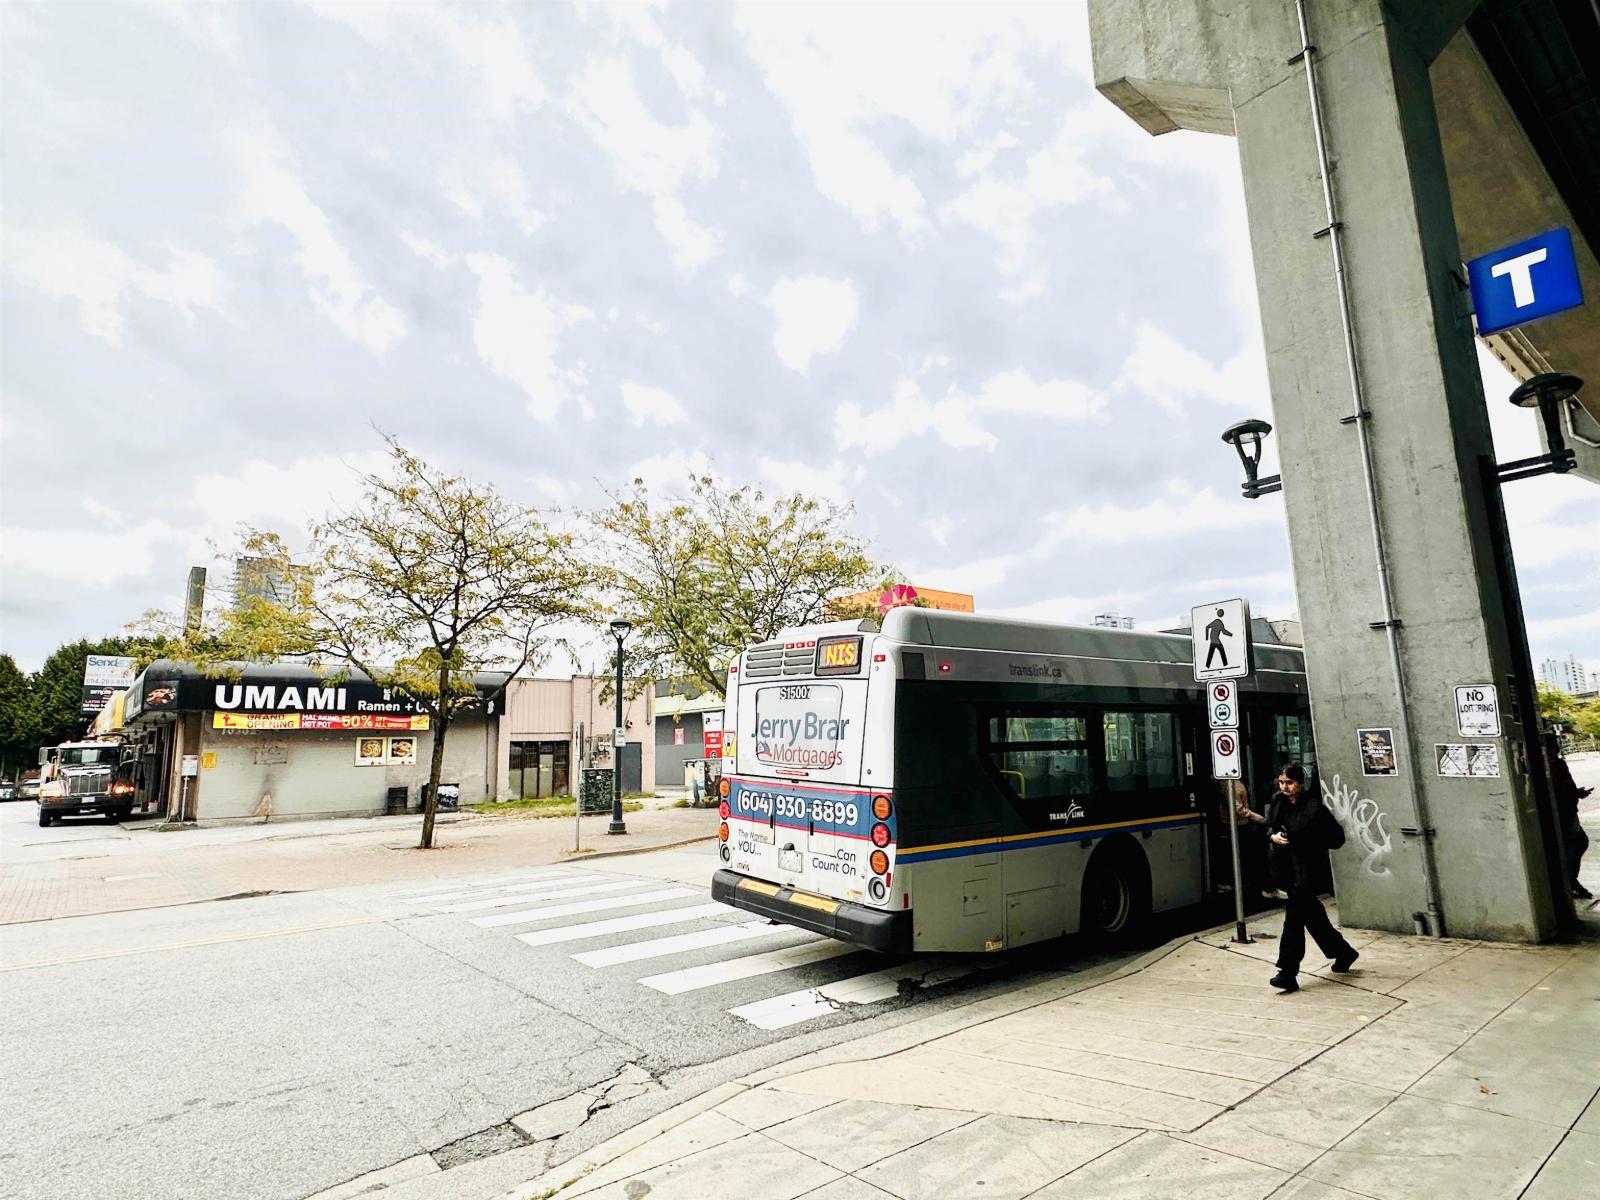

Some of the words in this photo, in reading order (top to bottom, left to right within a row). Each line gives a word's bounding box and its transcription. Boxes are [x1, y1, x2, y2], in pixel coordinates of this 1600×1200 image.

[1491, 247, 1547, 309] T
[1009, 664, 1062, 678] translink.ca
[215, 684, 347, 710] UMAMI
[1466, 691, 1484, 701] NO
[357, 700, 400, 712] Ramen
[404, 702, 413, 711] +
[1460, 703, 1495, 713] LOITRING
[247, 720, 295, 729] OPENING
[341, 715, 374, 727] 50%
[751, 712, 801, 747] Jerry
[804, 711, 850, 741] Brar
[773, 743, 843, 766] Mortgages
[737, 789, 773, 816] (604)
[776, 794, 858, 826] 930-8899
[812, 857, 839, 873] Count
[842, 863, 856, 875] On
